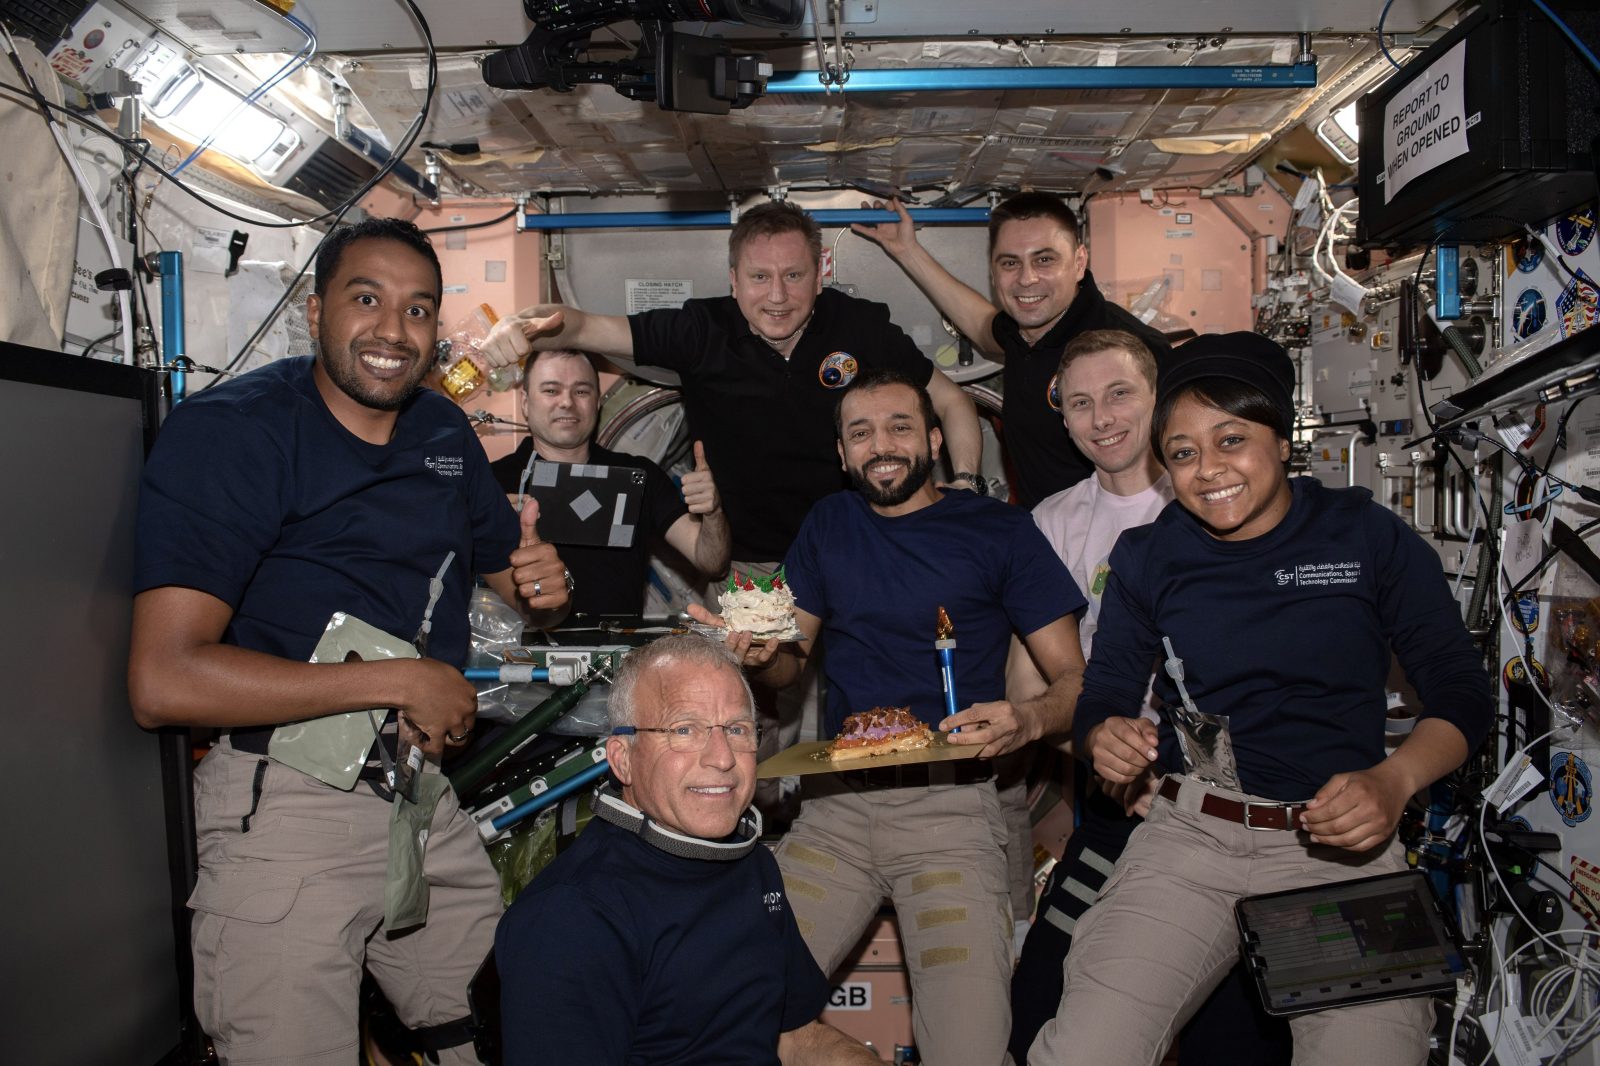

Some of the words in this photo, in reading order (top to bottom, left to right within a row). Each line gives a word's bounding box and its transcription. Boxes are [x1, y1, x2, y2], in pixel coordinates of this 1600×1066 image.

[1393, 85, 1432, 130] REPORT
[1434, 73, 1449, 95] TO
[1396, 103, 1441, 147] GROUND
[1387, 147, 1409, 179] WHEN
[1411, 116, 1460, 157] OPENED
[1299, 570, 1344, 579] Communications,
[1299, 578, 1329, 586] Technology
[1576, 882, 1590, 895] FIRE
[1591, 889, 1600, 901] PO
[829, 986, 866, 1006] GB
